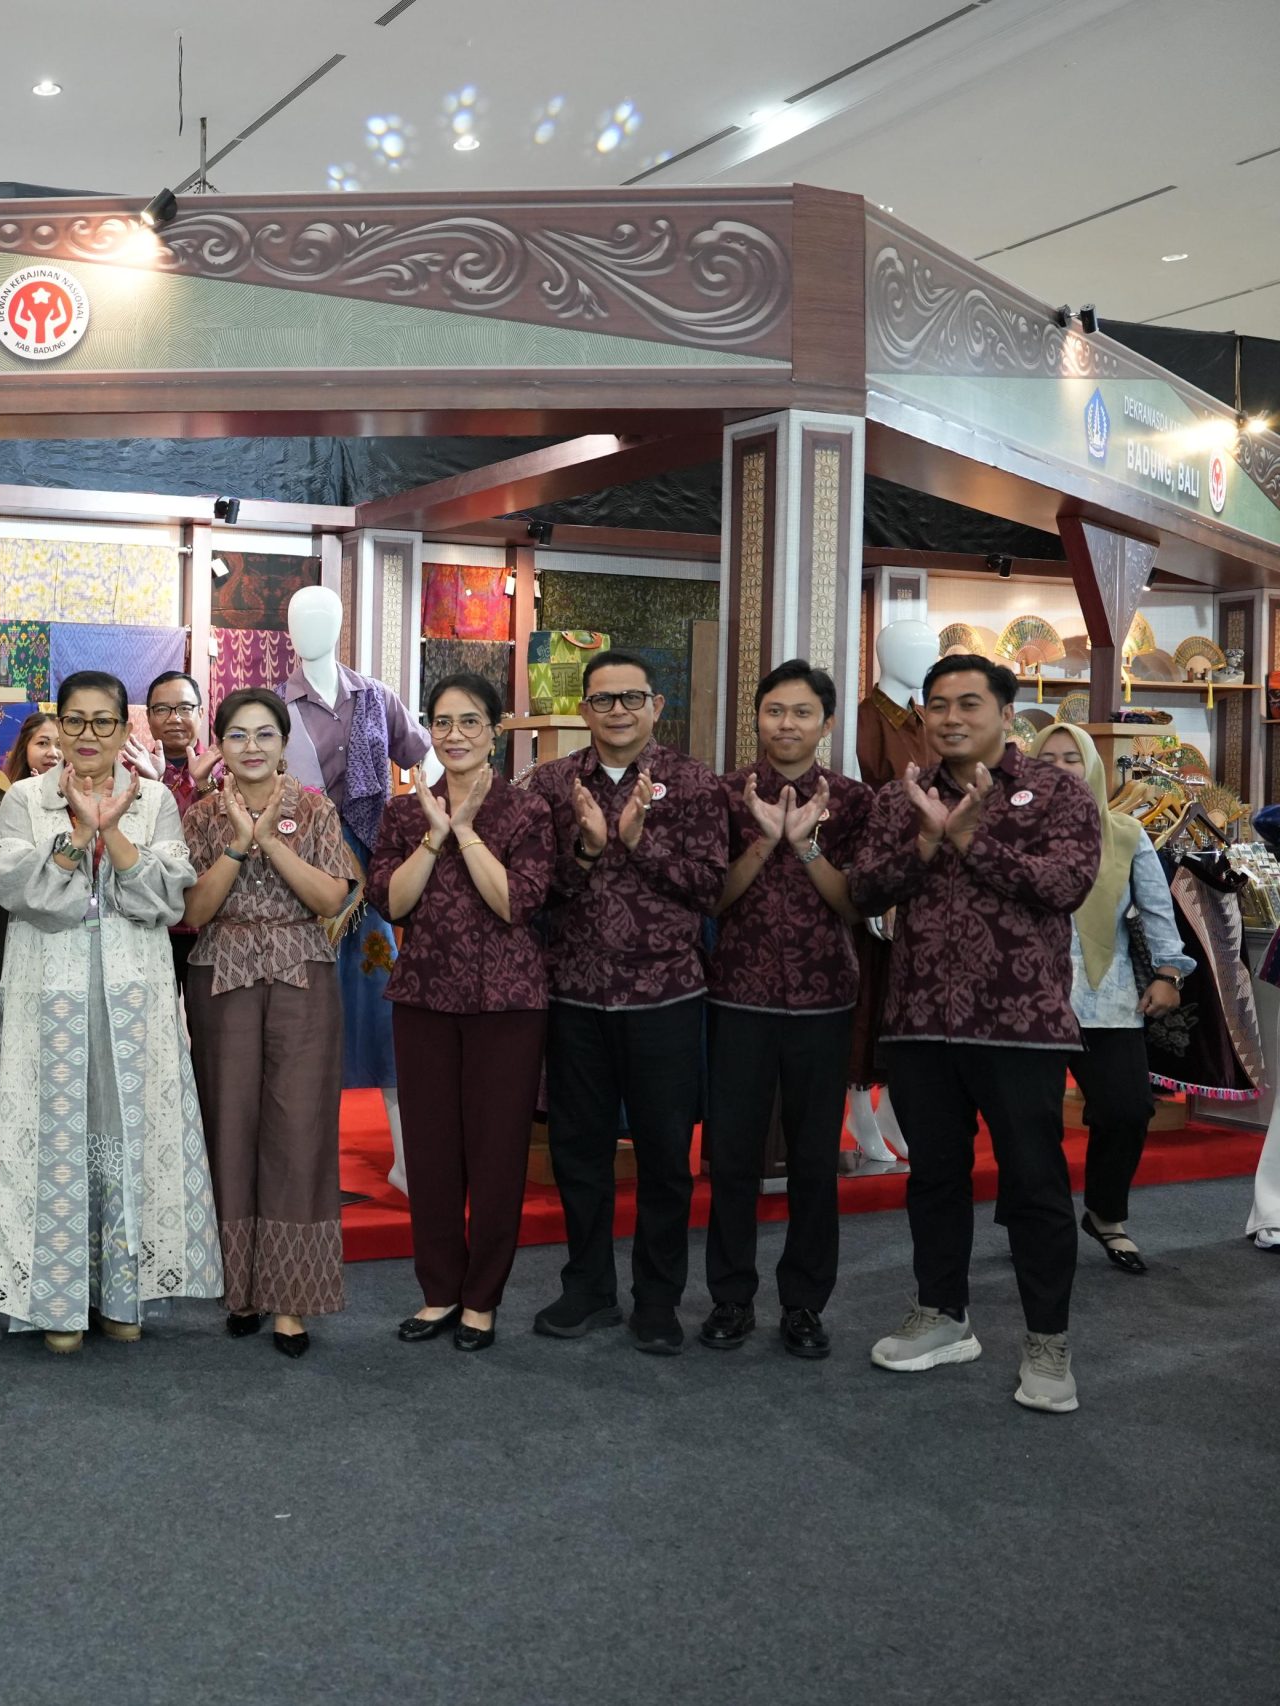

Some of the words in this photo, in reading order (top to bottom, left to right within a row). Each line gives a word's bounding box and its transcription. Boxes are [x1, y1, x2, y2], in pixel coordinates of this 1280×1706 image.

[9, 269, 61, 289] KERAJINAN
[62, 277, 85, 320] NASIONAL
[14, 340, 31, 353] KAB.
[33, 340, 66, 354] BADUNG
[1124, 395, 1168, 432] DEKRANASDA
[1177, 461, 1200, 498] BALI
